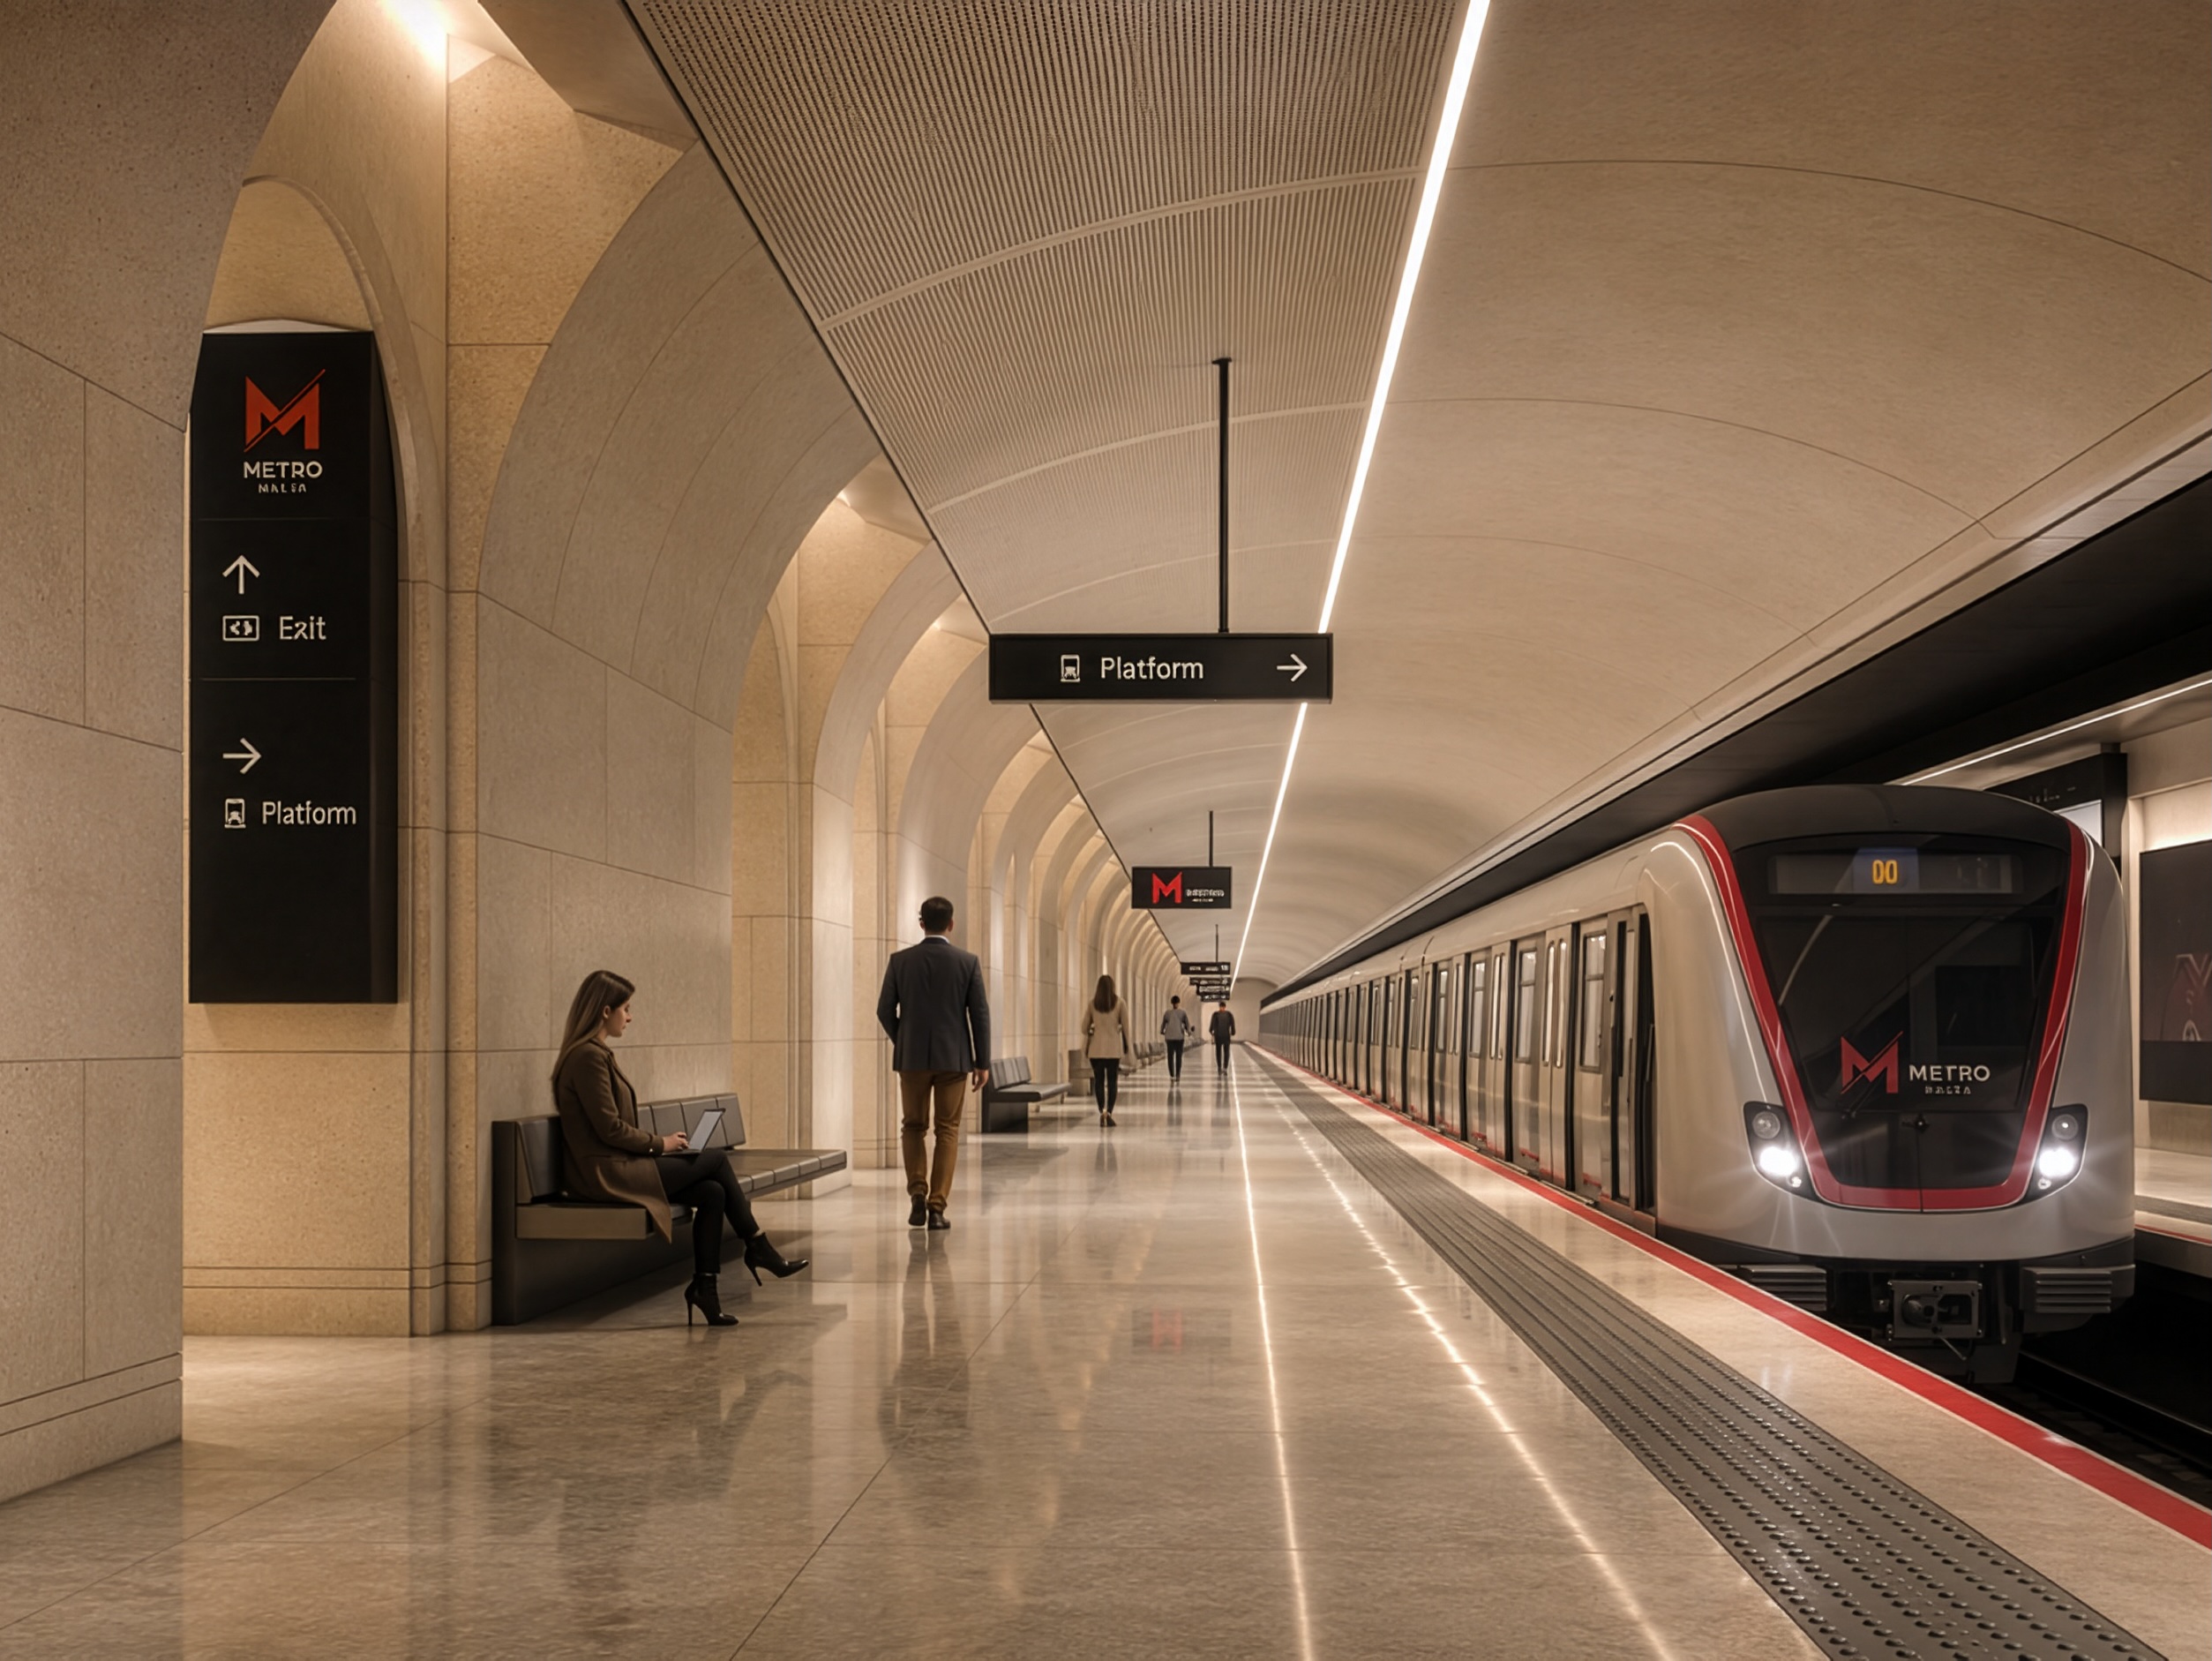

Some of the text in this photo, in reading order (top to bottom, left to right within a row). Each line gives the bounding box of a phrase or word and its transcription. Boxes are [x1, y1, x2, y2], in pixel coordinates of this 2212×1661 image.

[244, 461, 323, 479] METRO
[279, 615, 326, 641] Exit
[1100, 656, 1204, 680] Platform
[262, 800, 356, 825] Platform
[1871, 859, 1899, 884] 00
[1908, 1064, 1991, 1082] METRO
